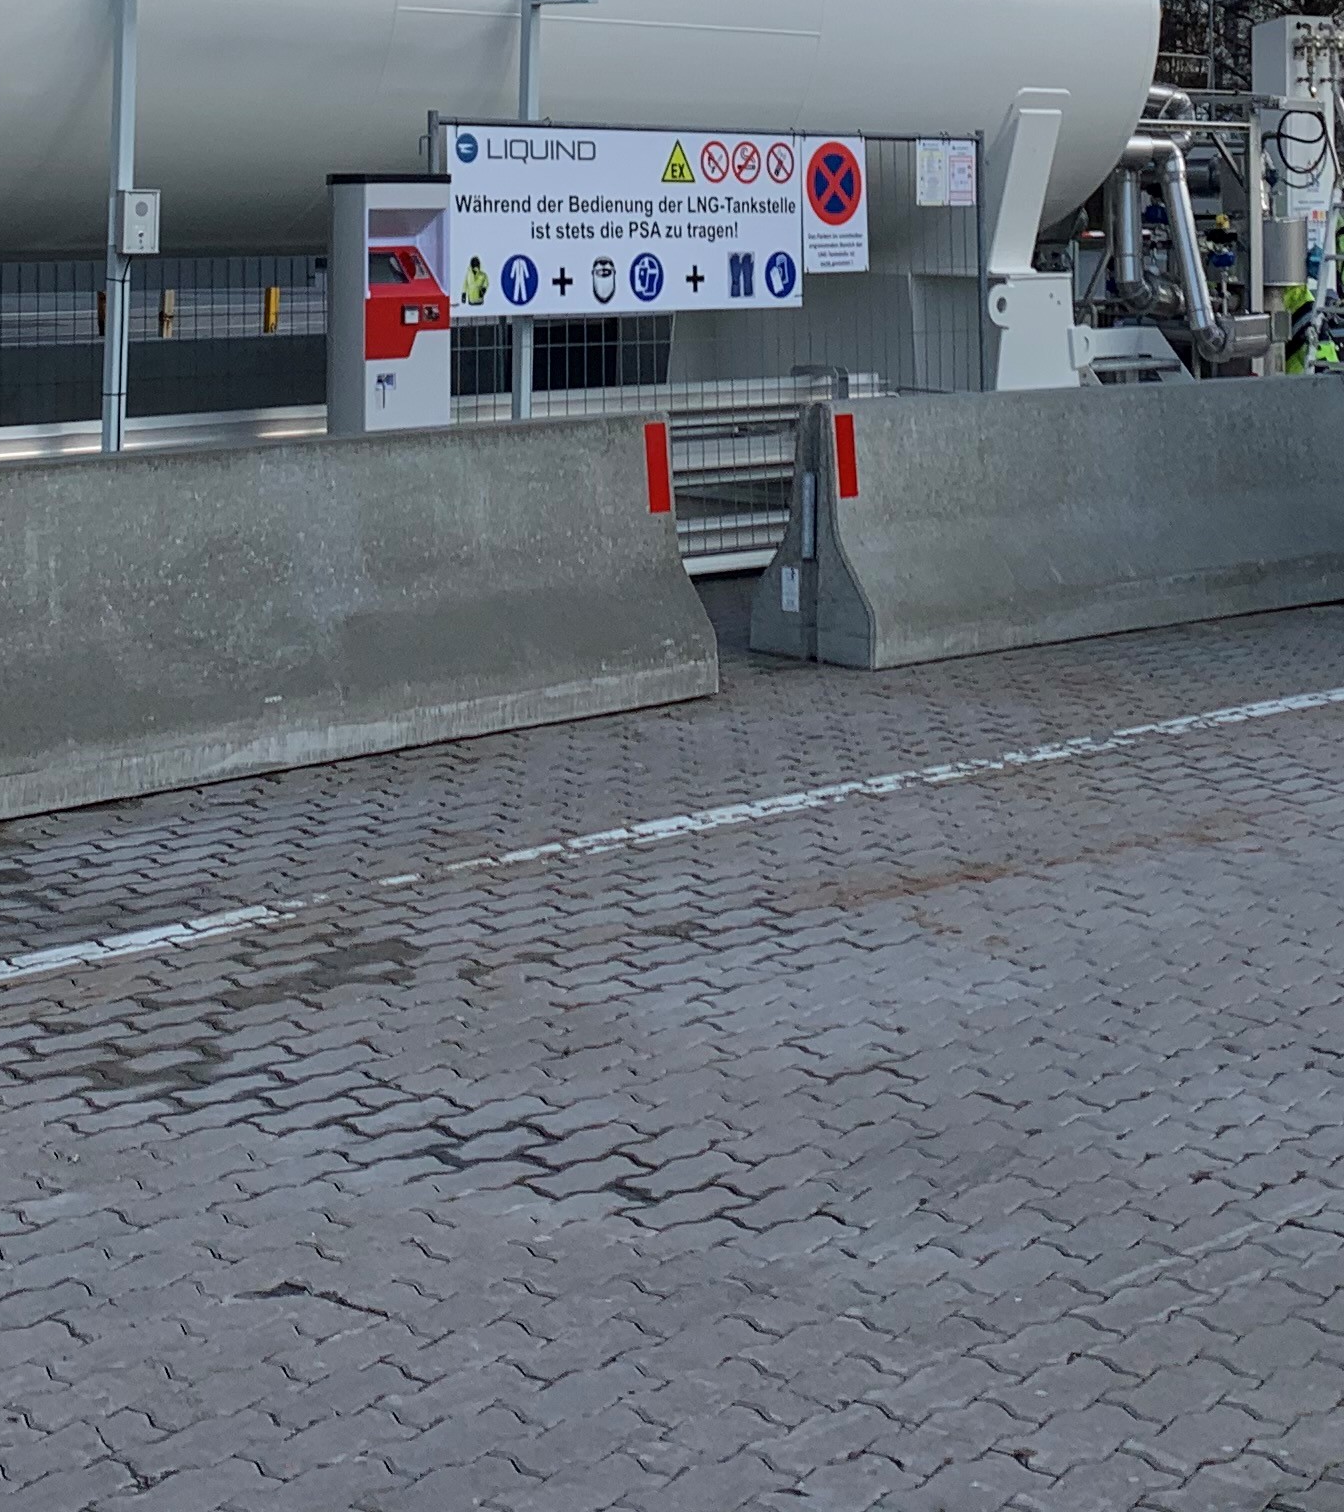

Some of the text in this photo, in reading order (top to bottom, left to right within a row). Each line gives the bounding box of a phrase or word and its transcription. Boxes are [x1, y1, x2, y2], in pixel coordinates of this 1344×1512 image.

[487, 138, 596, 164] LIQUIND
[671, 163, 685, 179] EX
[455, 194, 796, 217] Während der Bedienung der LNG-Tankstelle
[531, 221, 739, 242] ist stets die PSA zu tragen!
